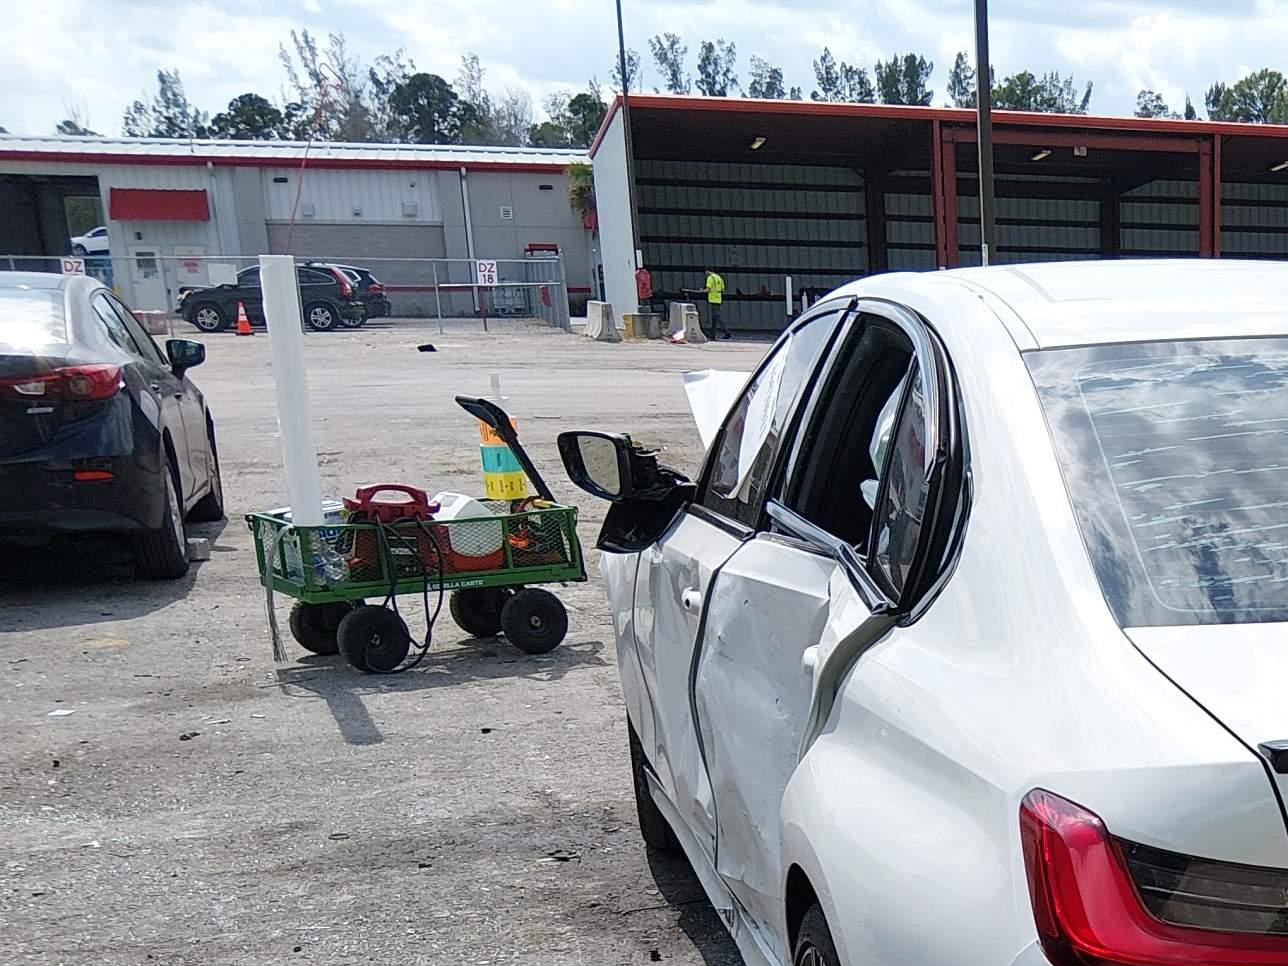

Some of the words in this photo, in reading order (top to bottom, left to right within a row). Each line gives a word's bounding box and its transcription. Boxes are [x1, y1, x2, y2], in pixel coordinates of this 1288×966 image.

[64, 261, 83, 272] DZ
[479, 263, 495, 273] DZ
[482, 274, 494, 284] 18
